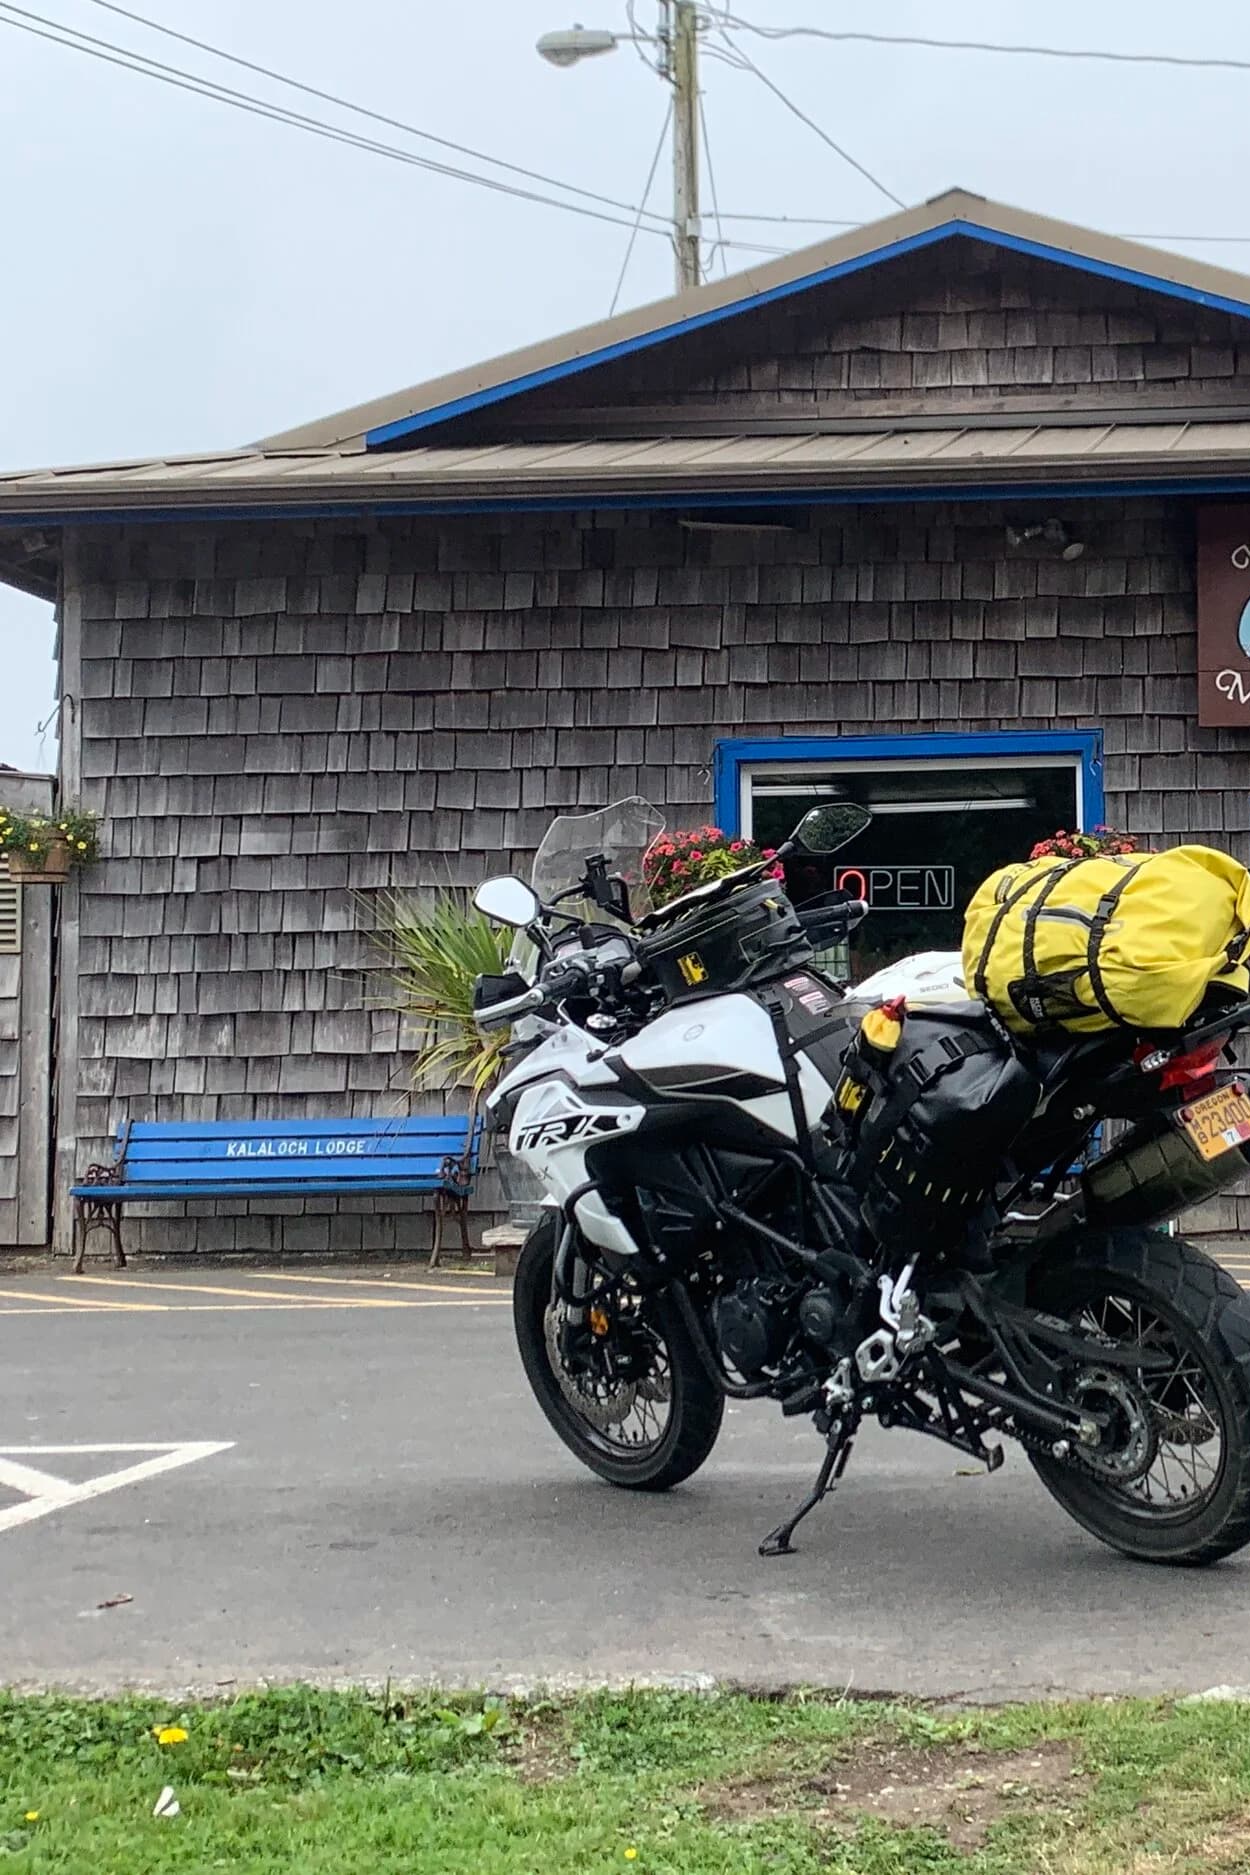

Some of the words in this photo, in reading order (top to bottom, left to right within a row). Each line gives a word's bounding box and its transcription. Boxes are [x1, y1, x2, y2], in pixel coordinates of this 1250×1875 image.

[839, 870, 948, 905] OPEN
[1194, 1091, 1230, 1115] OREGON
[1226, 1131, 1236, 1143] 7
[226, 1140, 308, 1157] KALALOCH
[316, 1139, 367, 1155] LODGE
